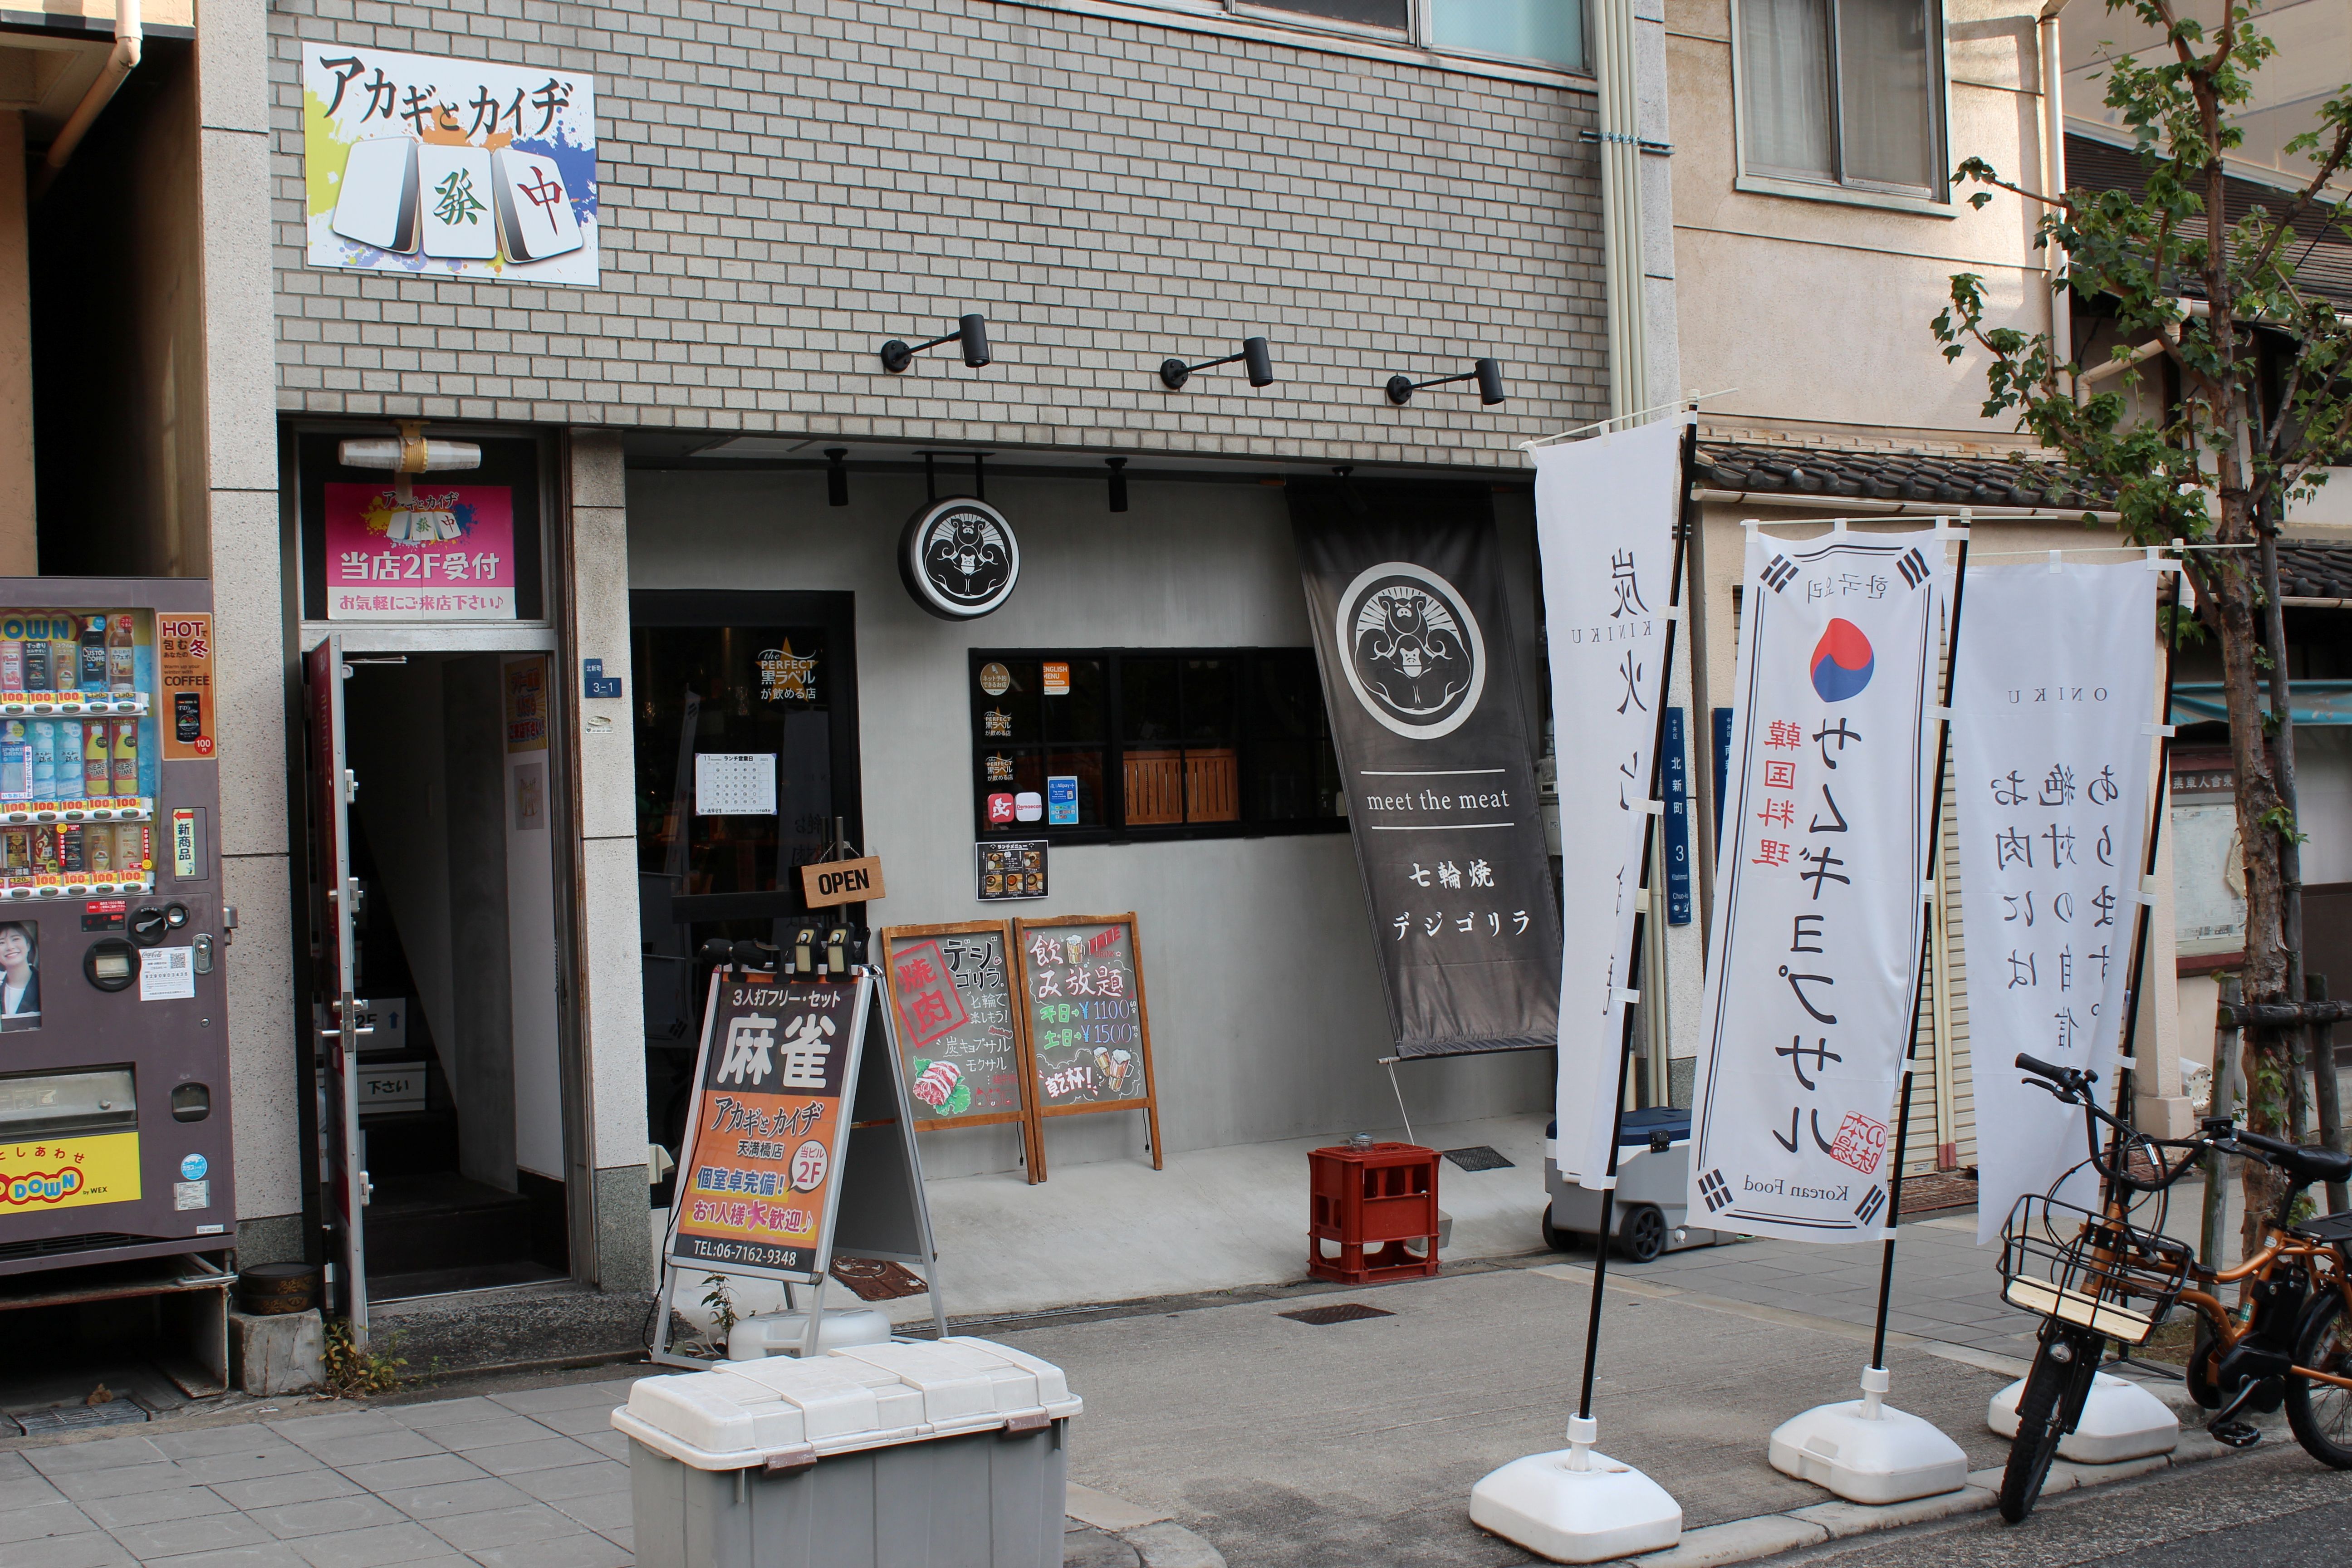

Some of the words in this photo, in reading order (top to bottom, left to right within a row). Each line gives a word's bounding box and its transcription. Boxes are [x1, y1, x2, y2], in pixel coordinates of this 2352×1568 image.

[320, 55, 573, 139] アカギとカイヂ
[516, 166, 563, 237] 中
[441, 514, 456, 534] 中
[340, 551, 500, 581] 当店2F受付
[0, 620, 69, 639] OWN
[189, 638, 209, 659] 冬
[764, 650, 780, 661] the
[761, 660, 815, 669] PERFECT
[165, 676, 210, 686] COFFEE
[593, 682, 613, 693] 3-1
[761, 670, 815, 685] 黒ラベル
[761, 688, 816, 700] が飲める店
[196, 739, 211, 748] 100
[987, 766, 1013, 774] 黒ラベル
[1671, 756, 1683, 815] 北新町
[1367, 792, 1414, 811] meet
[1419, 789, 1452, 810] the
[1458, 789, 1510, 809] meat
[178, 823, 191, 861] 新商品
[1676, 845, 1685, 862] 3
[818, 868, 869, 895] OPEN
[1408, 858, 1495, 890] 七輪焼
[1392, 909, 1530, 941] デジゴリラ
[732, 988, 841, 1009] 3人打フリー・セット
[897, 958, 952, 1034] 焼肉
[969, 1009, 1008, 1024] 楽しもう!
[1039, 1004, 1070, 1024] 平日
[717, 1012, 836, 1088] 麻雀
[965, 1056, 1007, 1072] モクサル
[1045, 1066, 1092, 1099] 乾杯!
[711, 1096, 824, 1138] アカギとカイヂ
[736, 1140, 784, 1160] 天満橋店
[799, 1146, 824, 1159] 当ビル
[697, 1166, 785, 1196] 個室卓完備!
[799, 1161, 822, 1184] 2F
[15, 1174, 75, 1199] DOWN
[694, 1240, 797, 1267] TEL:06-7162-9348
